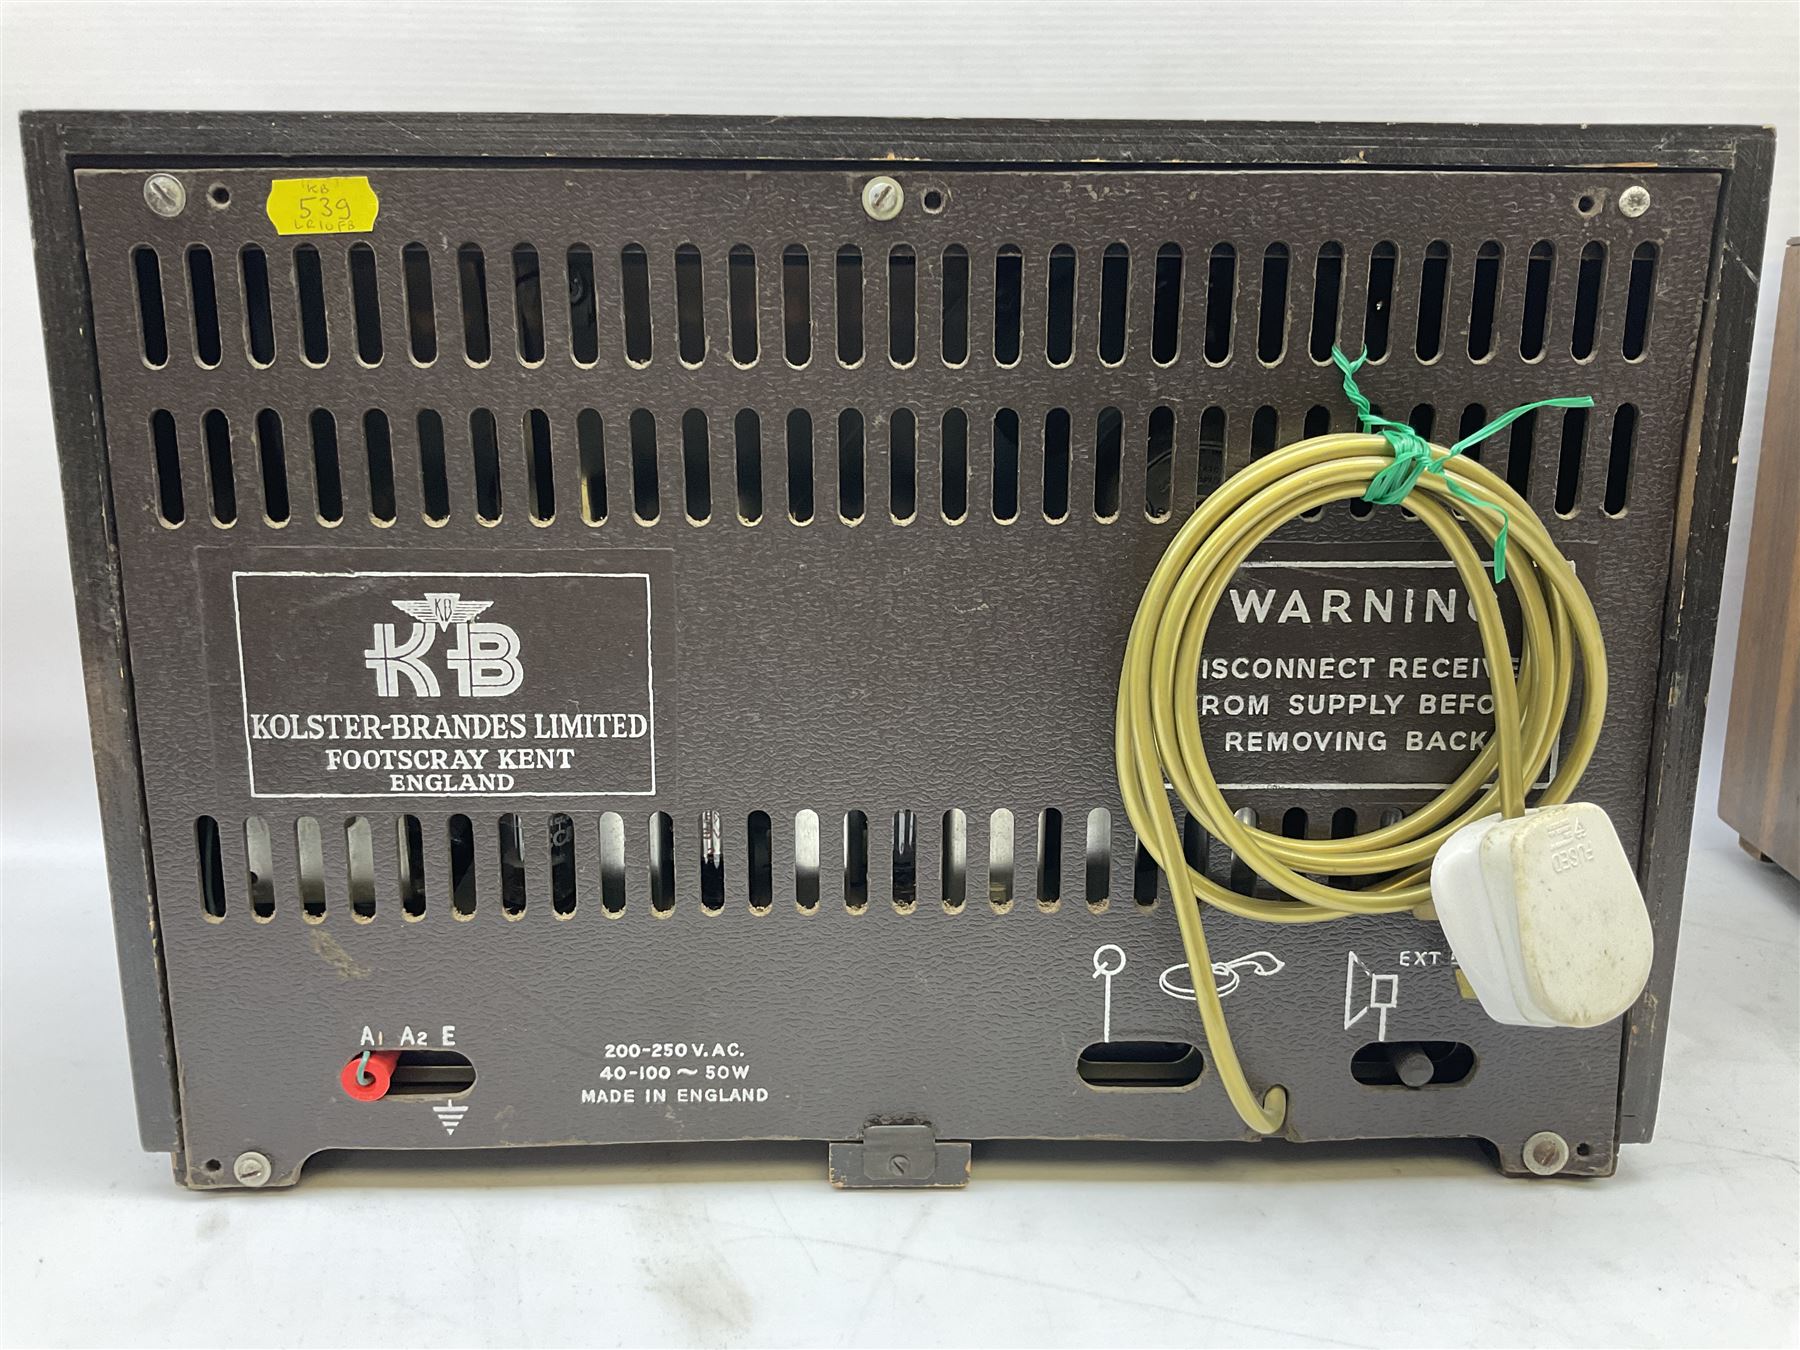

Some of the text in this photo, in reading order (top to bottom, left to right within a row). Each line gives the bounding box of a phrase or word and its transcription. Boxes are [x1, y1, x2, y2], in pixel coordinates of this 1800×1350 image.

[299, 196, 351, 221] 539
[364, 622, 524, 698] KB
[1202, 657, 1376, 680] ISCONNECT
[1201, 693, 1495, 716] ROM SUPPLY BEFO
[250, 713, 648, 740] KOLSTER-BRANDES LIMITED
[1225, 730, 1488, 752] REMOVING BACK
[325, 748, 575, 771] FOOTSCRAY KENT
[389, 773, 515, 792] ENGLAND
[1399, 950, 1442, 967] EXT
[400, 1025, 428, 1047] A2
[442, 1025, 456, 1046] E
[604, 1043, 688, 1059] 200-250
[599, 1065, 671, 1080] 40-100
[581, 1088, 769, 1103] MADE IN ENGLAND
